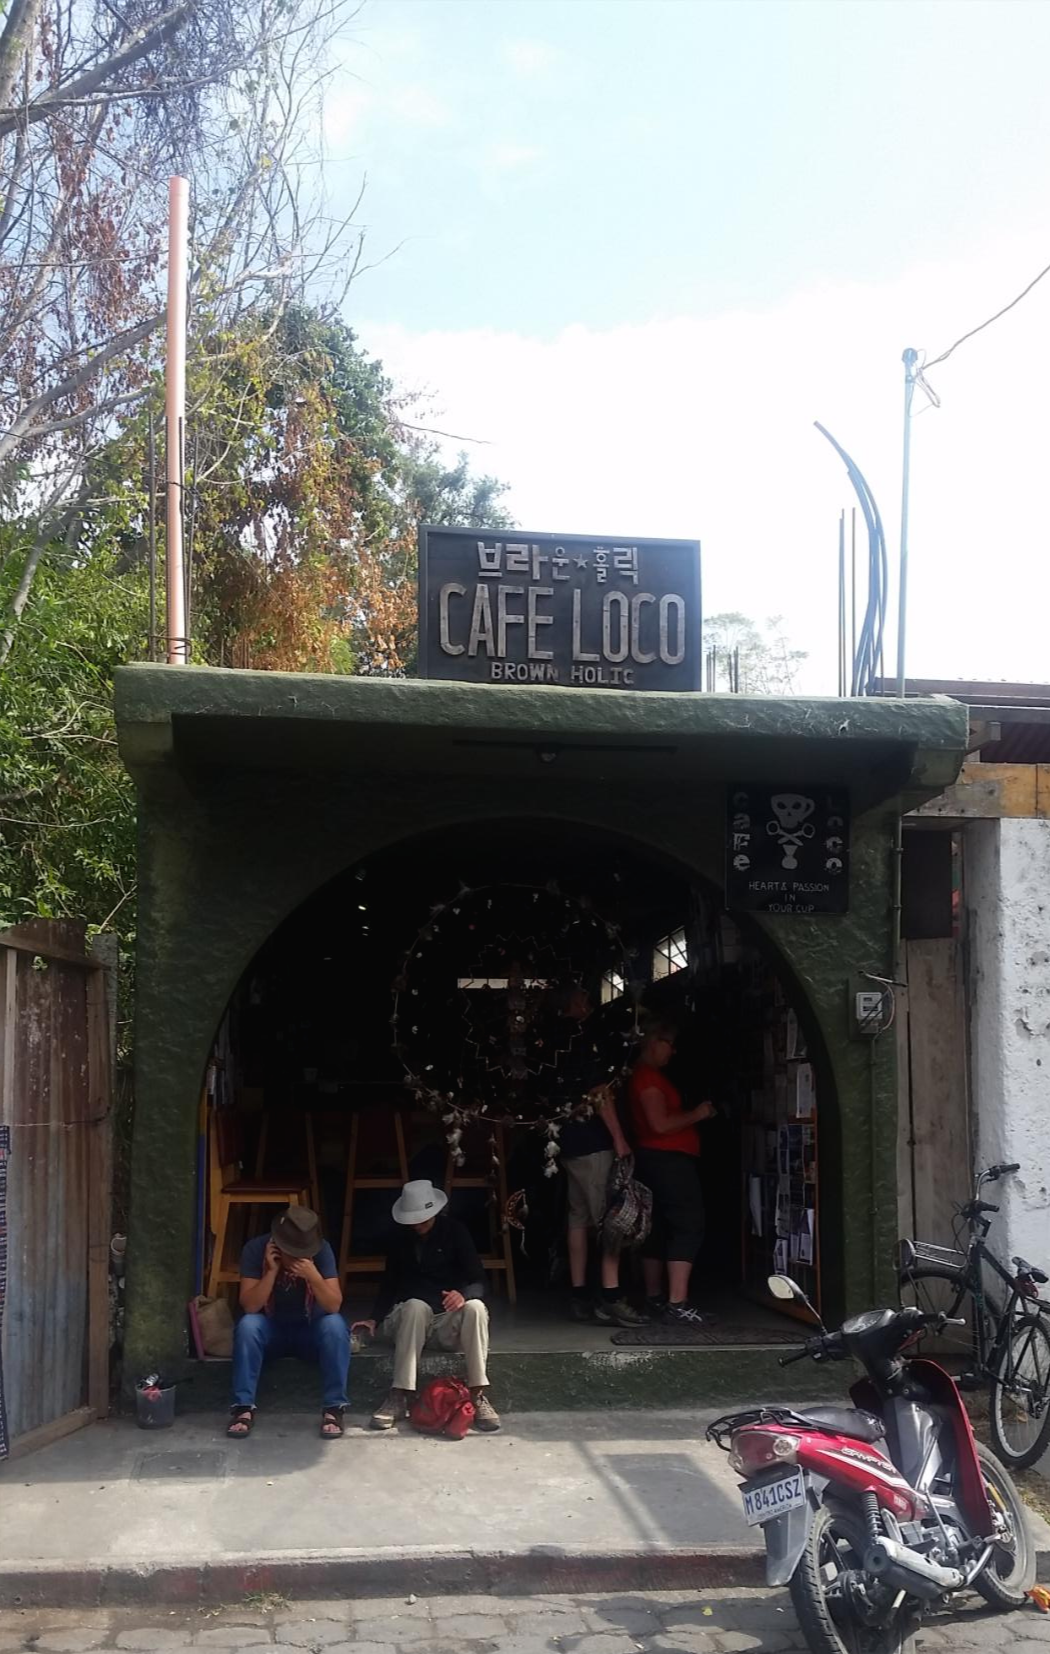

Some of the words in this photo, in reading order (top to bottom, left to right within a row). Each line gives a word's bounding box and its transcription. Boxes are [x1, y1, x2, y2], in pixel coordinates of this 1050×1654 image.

[439, 582, 554, 660] CAFE
[572, 588, 686, 665] LOCO
[491, 661, 559, 681] BROWN
[570, 665, 635, 685] HOLIC
[792, 882, 830, 892] PASSION
[784, 894, 796, 903] IN
[768, 904, 793, 913] YOUR
[796, 904, 815, 913] CUP
